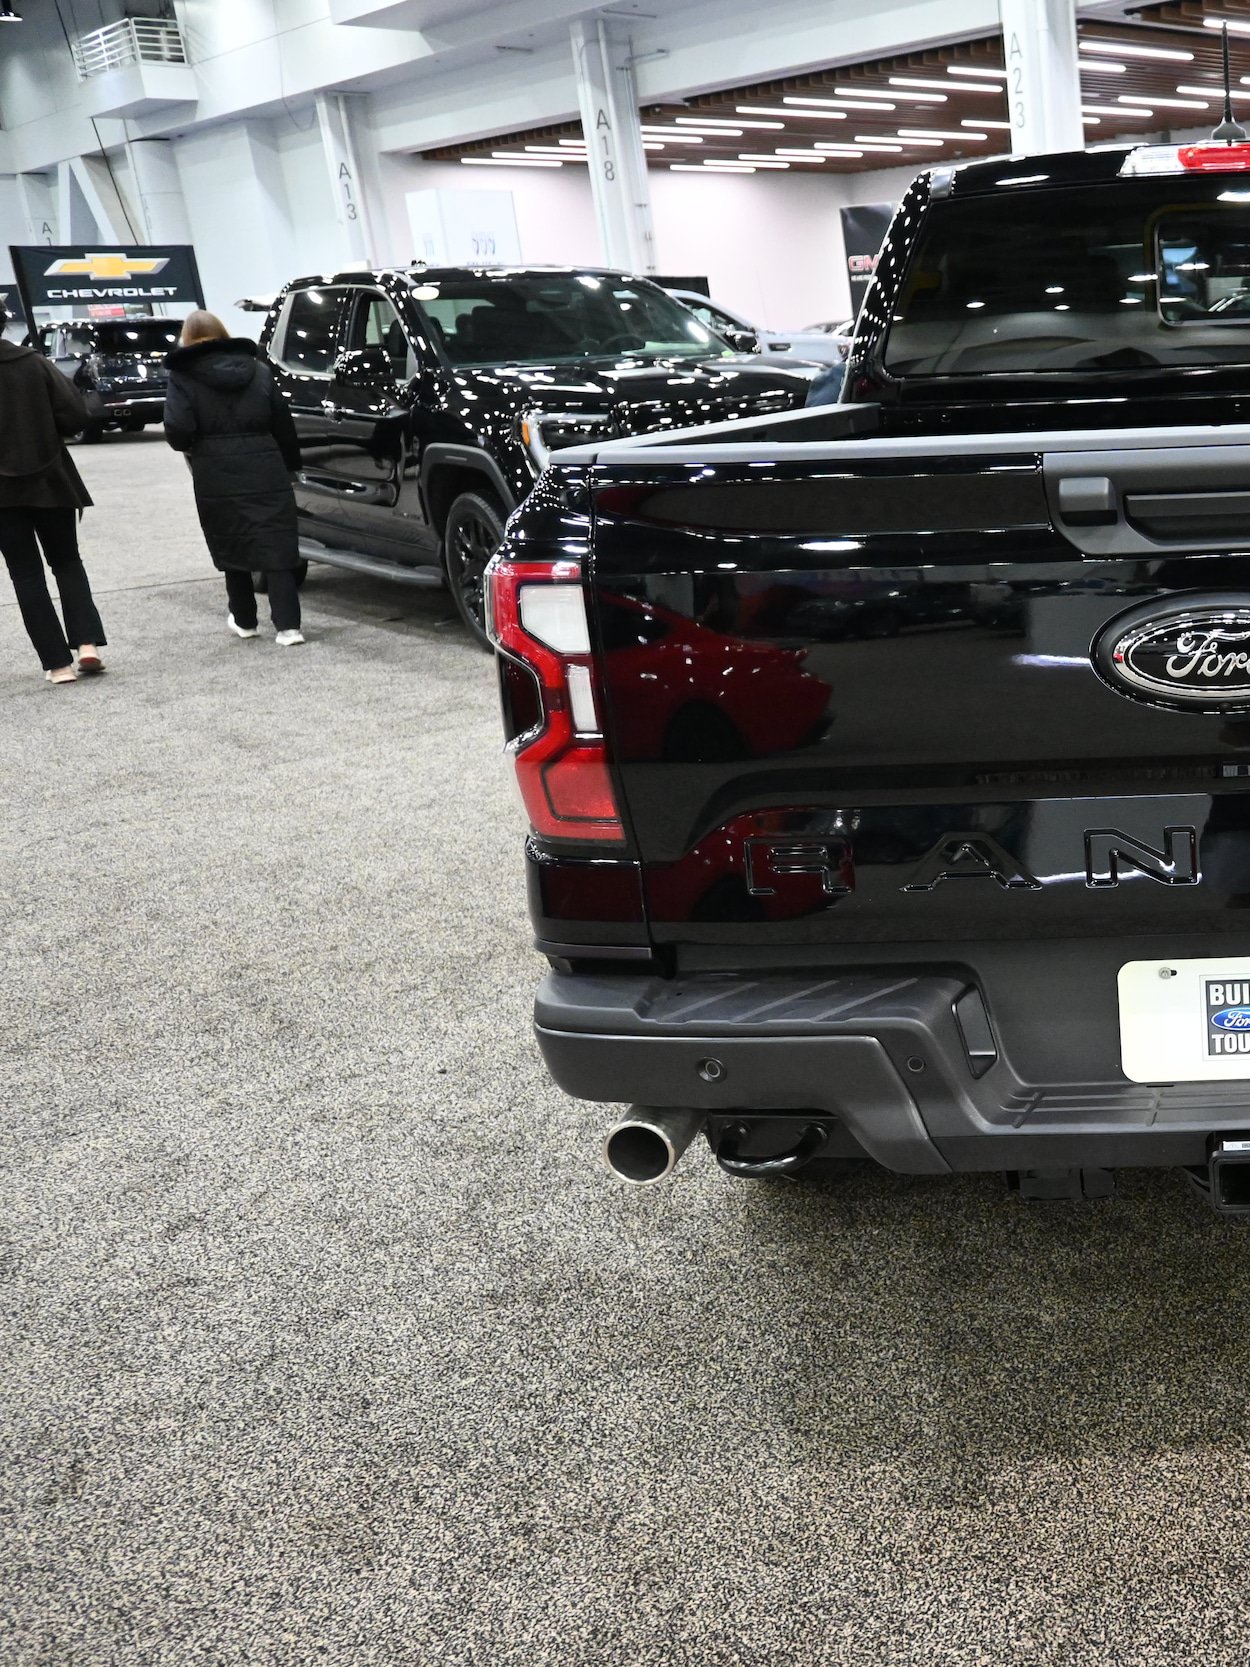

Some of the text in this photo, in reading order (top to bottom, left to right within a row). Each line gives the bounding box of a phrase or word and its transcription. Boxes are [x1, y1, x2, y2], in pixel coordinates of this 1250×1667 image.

[1010, 32, 1025, 128] A23
[596, 108, 615, 182] A18
[339, 162, 357, 220] A13
[848, 254, 880, 272] GM
[46, 286, 178, 299] CHEVROLET
